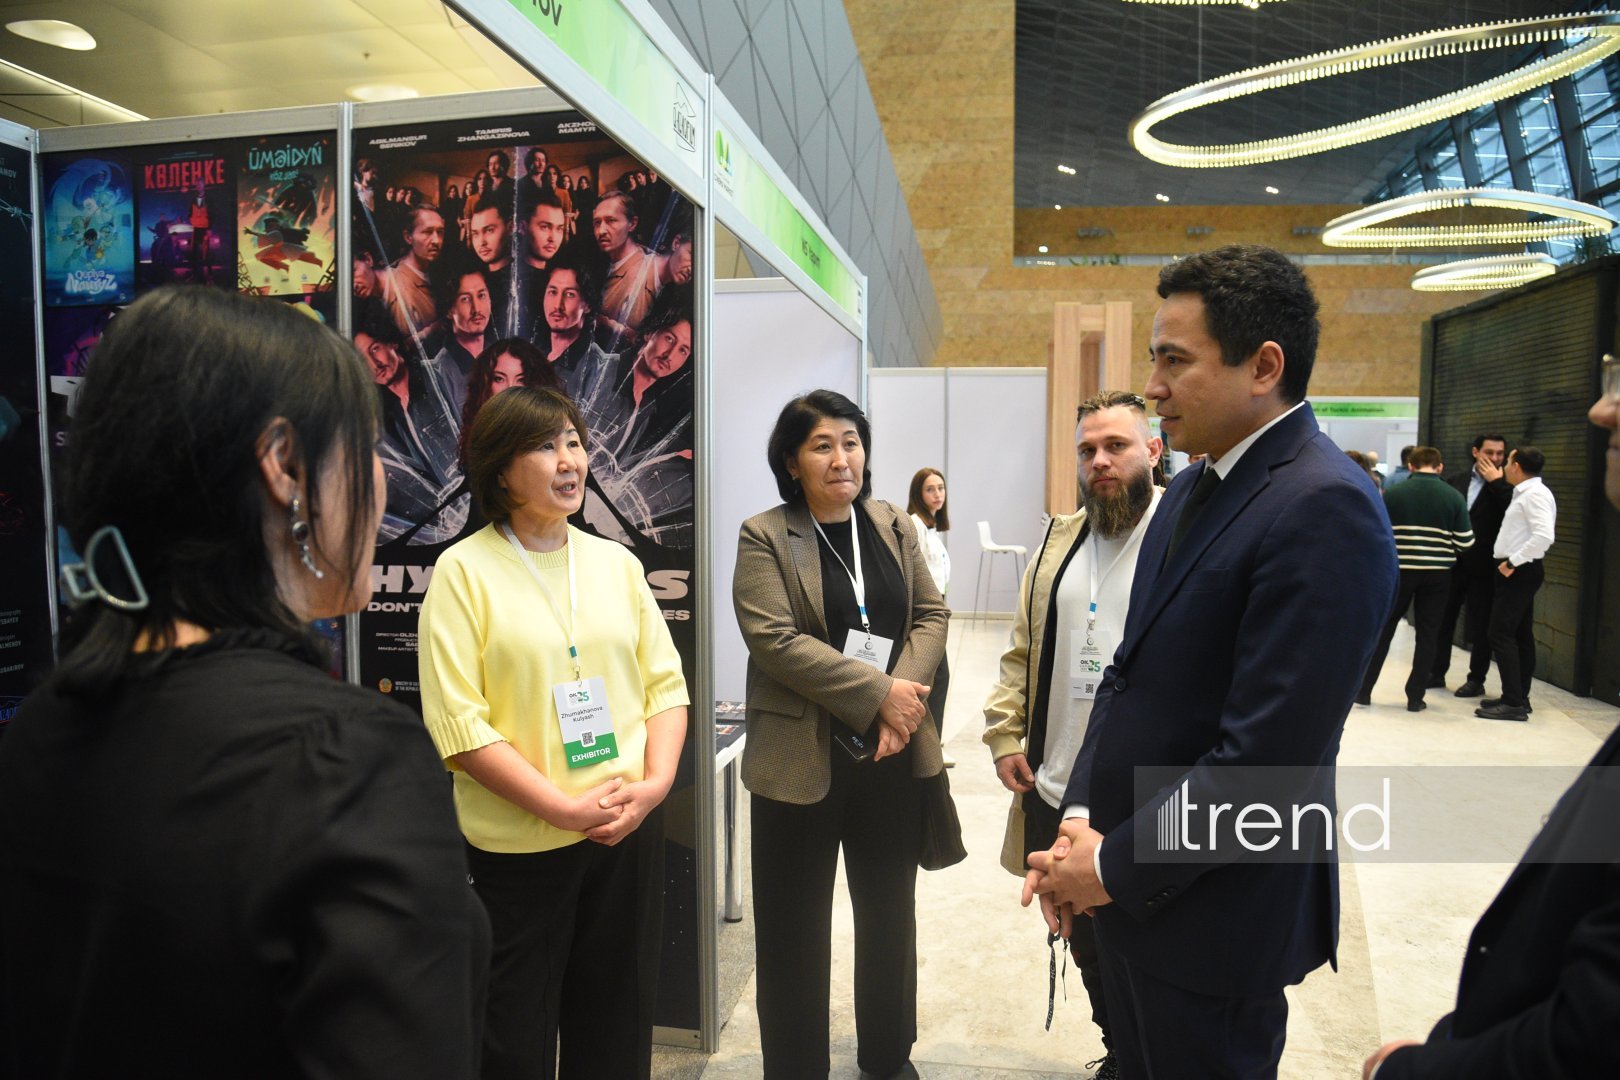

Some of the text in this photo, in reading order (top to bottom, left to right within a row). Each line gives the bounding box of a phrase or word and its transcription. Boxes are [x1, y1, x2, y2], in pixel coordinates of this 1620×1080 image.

[457, 131, 530, 142] ZHANGAZINOVA
[475, 127, 512, 135] TAMIRIS
[561, 706, 603, 719] Zhumakhanova
[573, 713, 595, 722] Kulyash
[571, 747, 611, 763] EXHIBITOR
